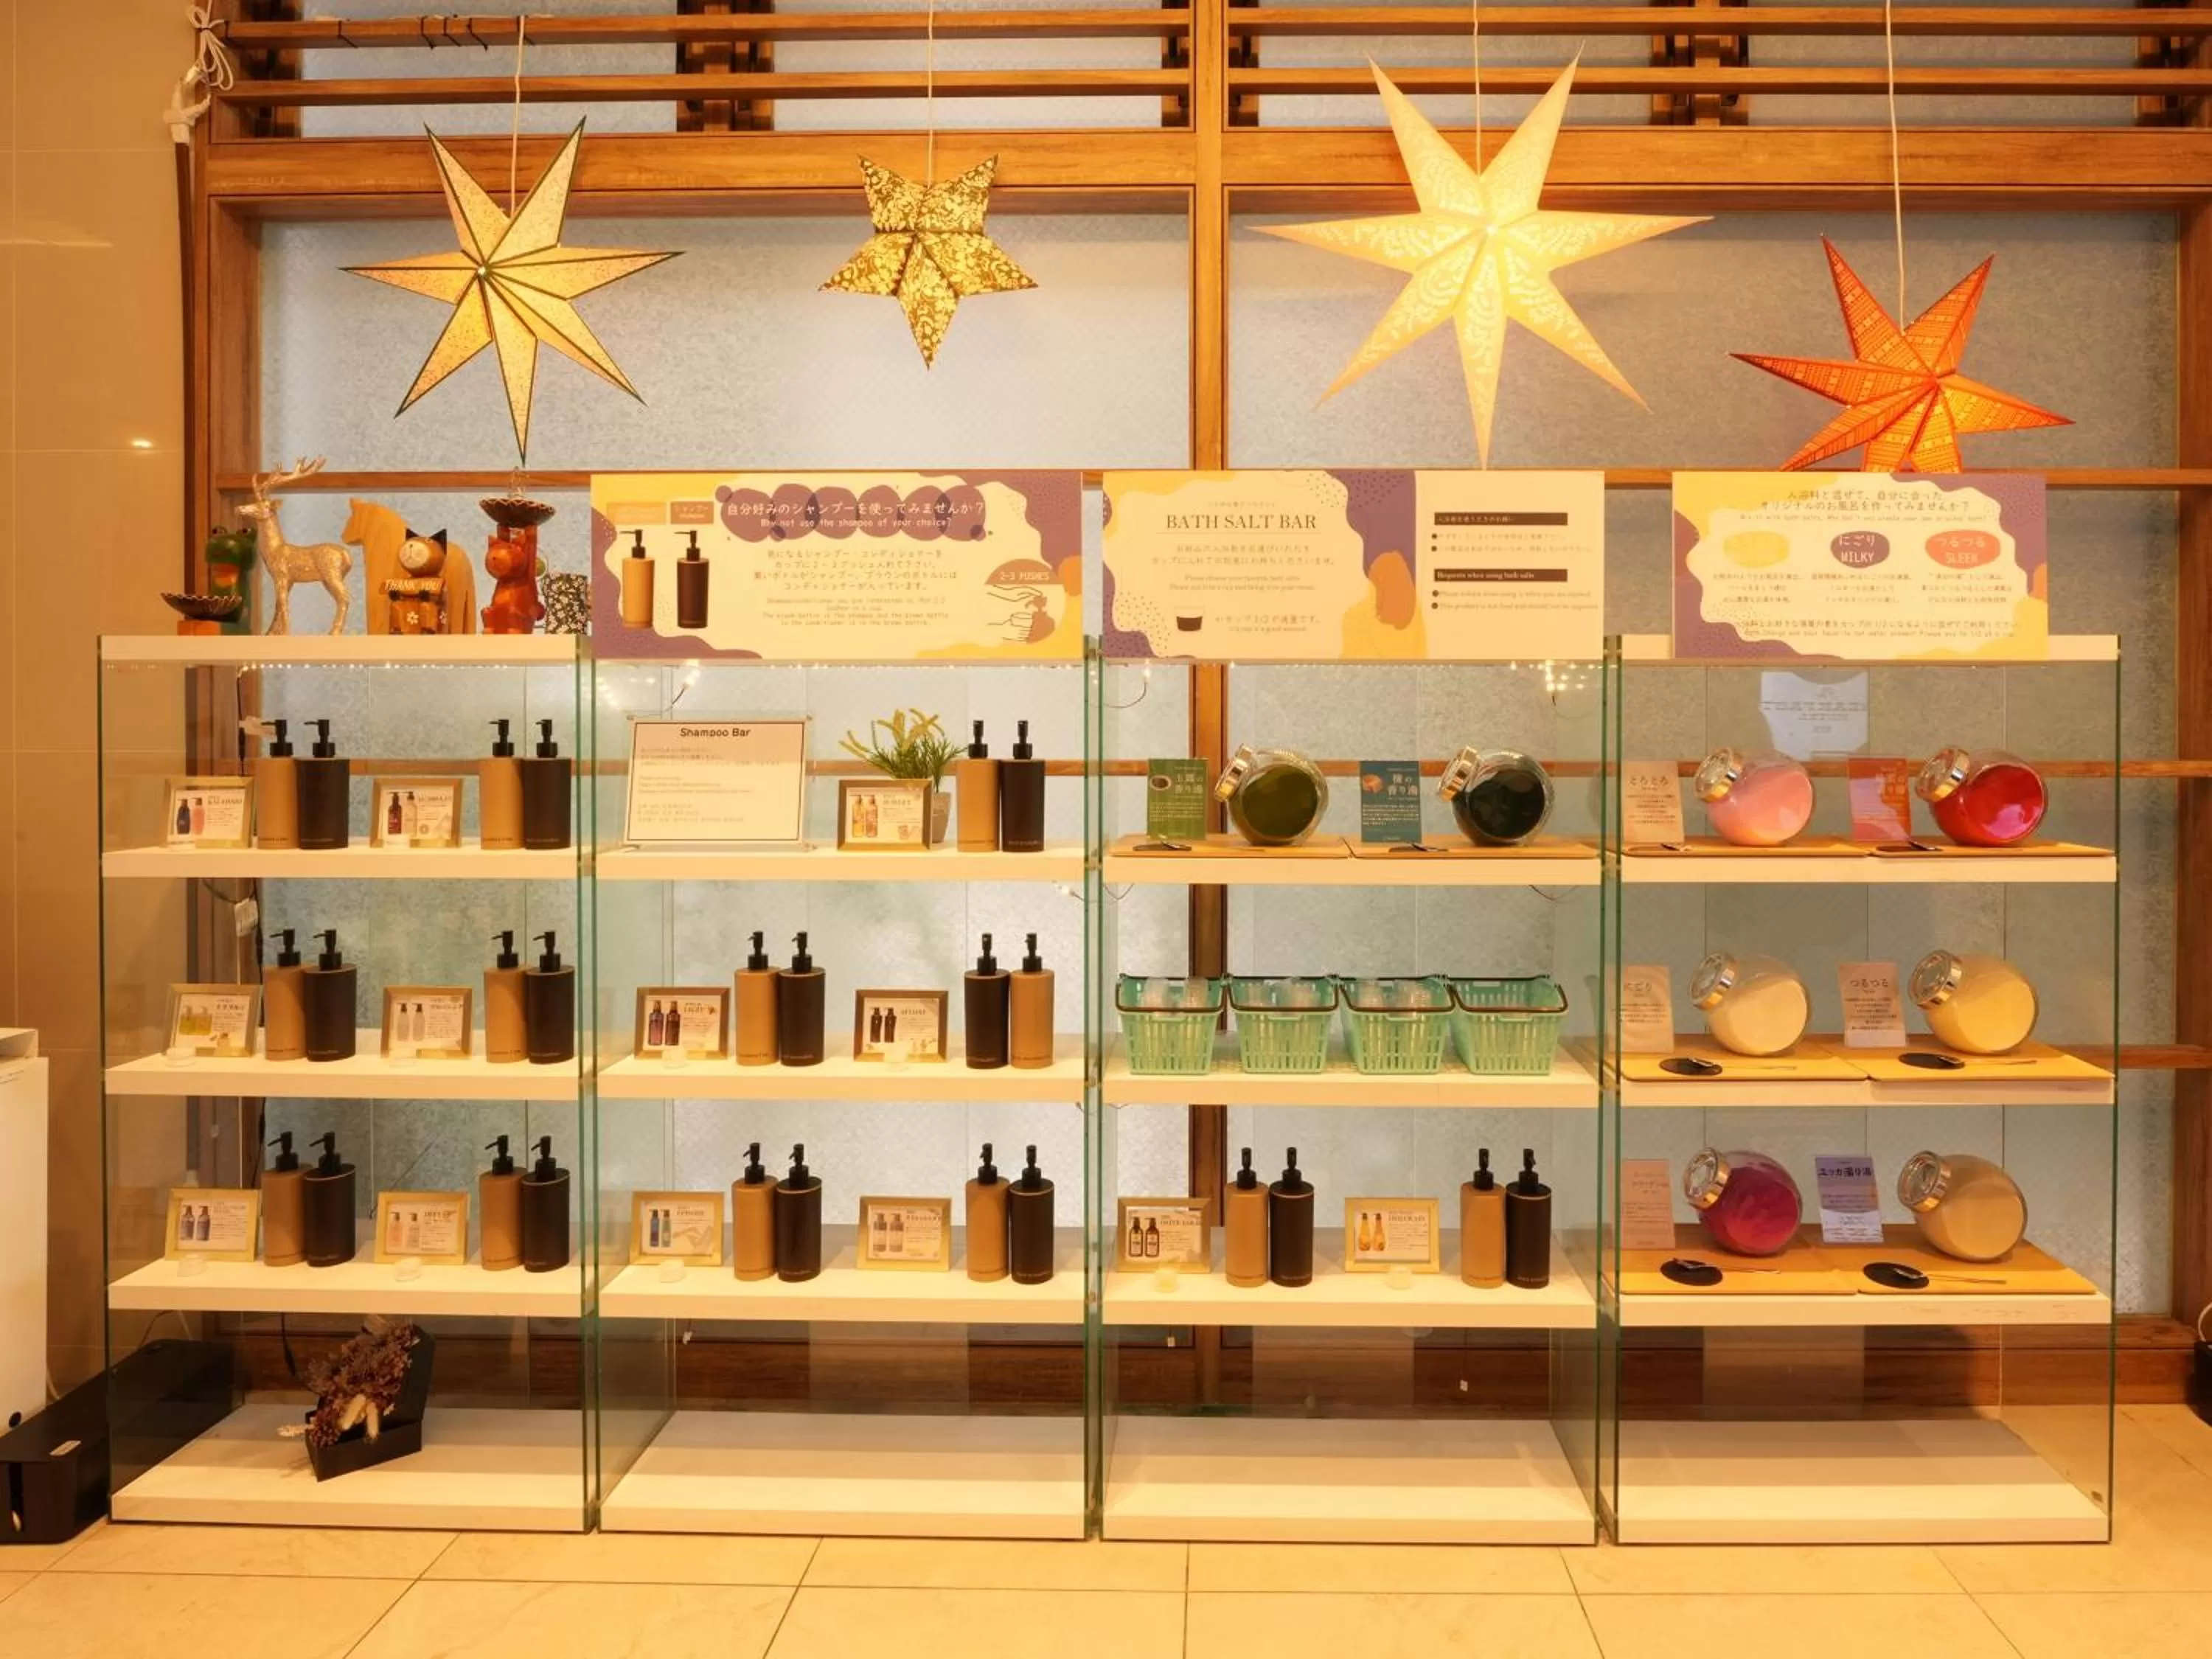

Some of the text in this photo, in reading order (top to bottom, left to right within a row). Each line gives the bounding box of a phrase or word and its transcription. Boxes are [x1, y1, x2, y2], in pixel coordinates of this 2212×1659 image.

[1166, 514, 1317, 529] BATH SALT BAR
[1839, 534, 1877, 546] にごり
[1935, 538, 1987, 549] つるつる
[1840, 552, 1876, 565] MILKY
[680, 727, 751, 737] Shampoo Bar
